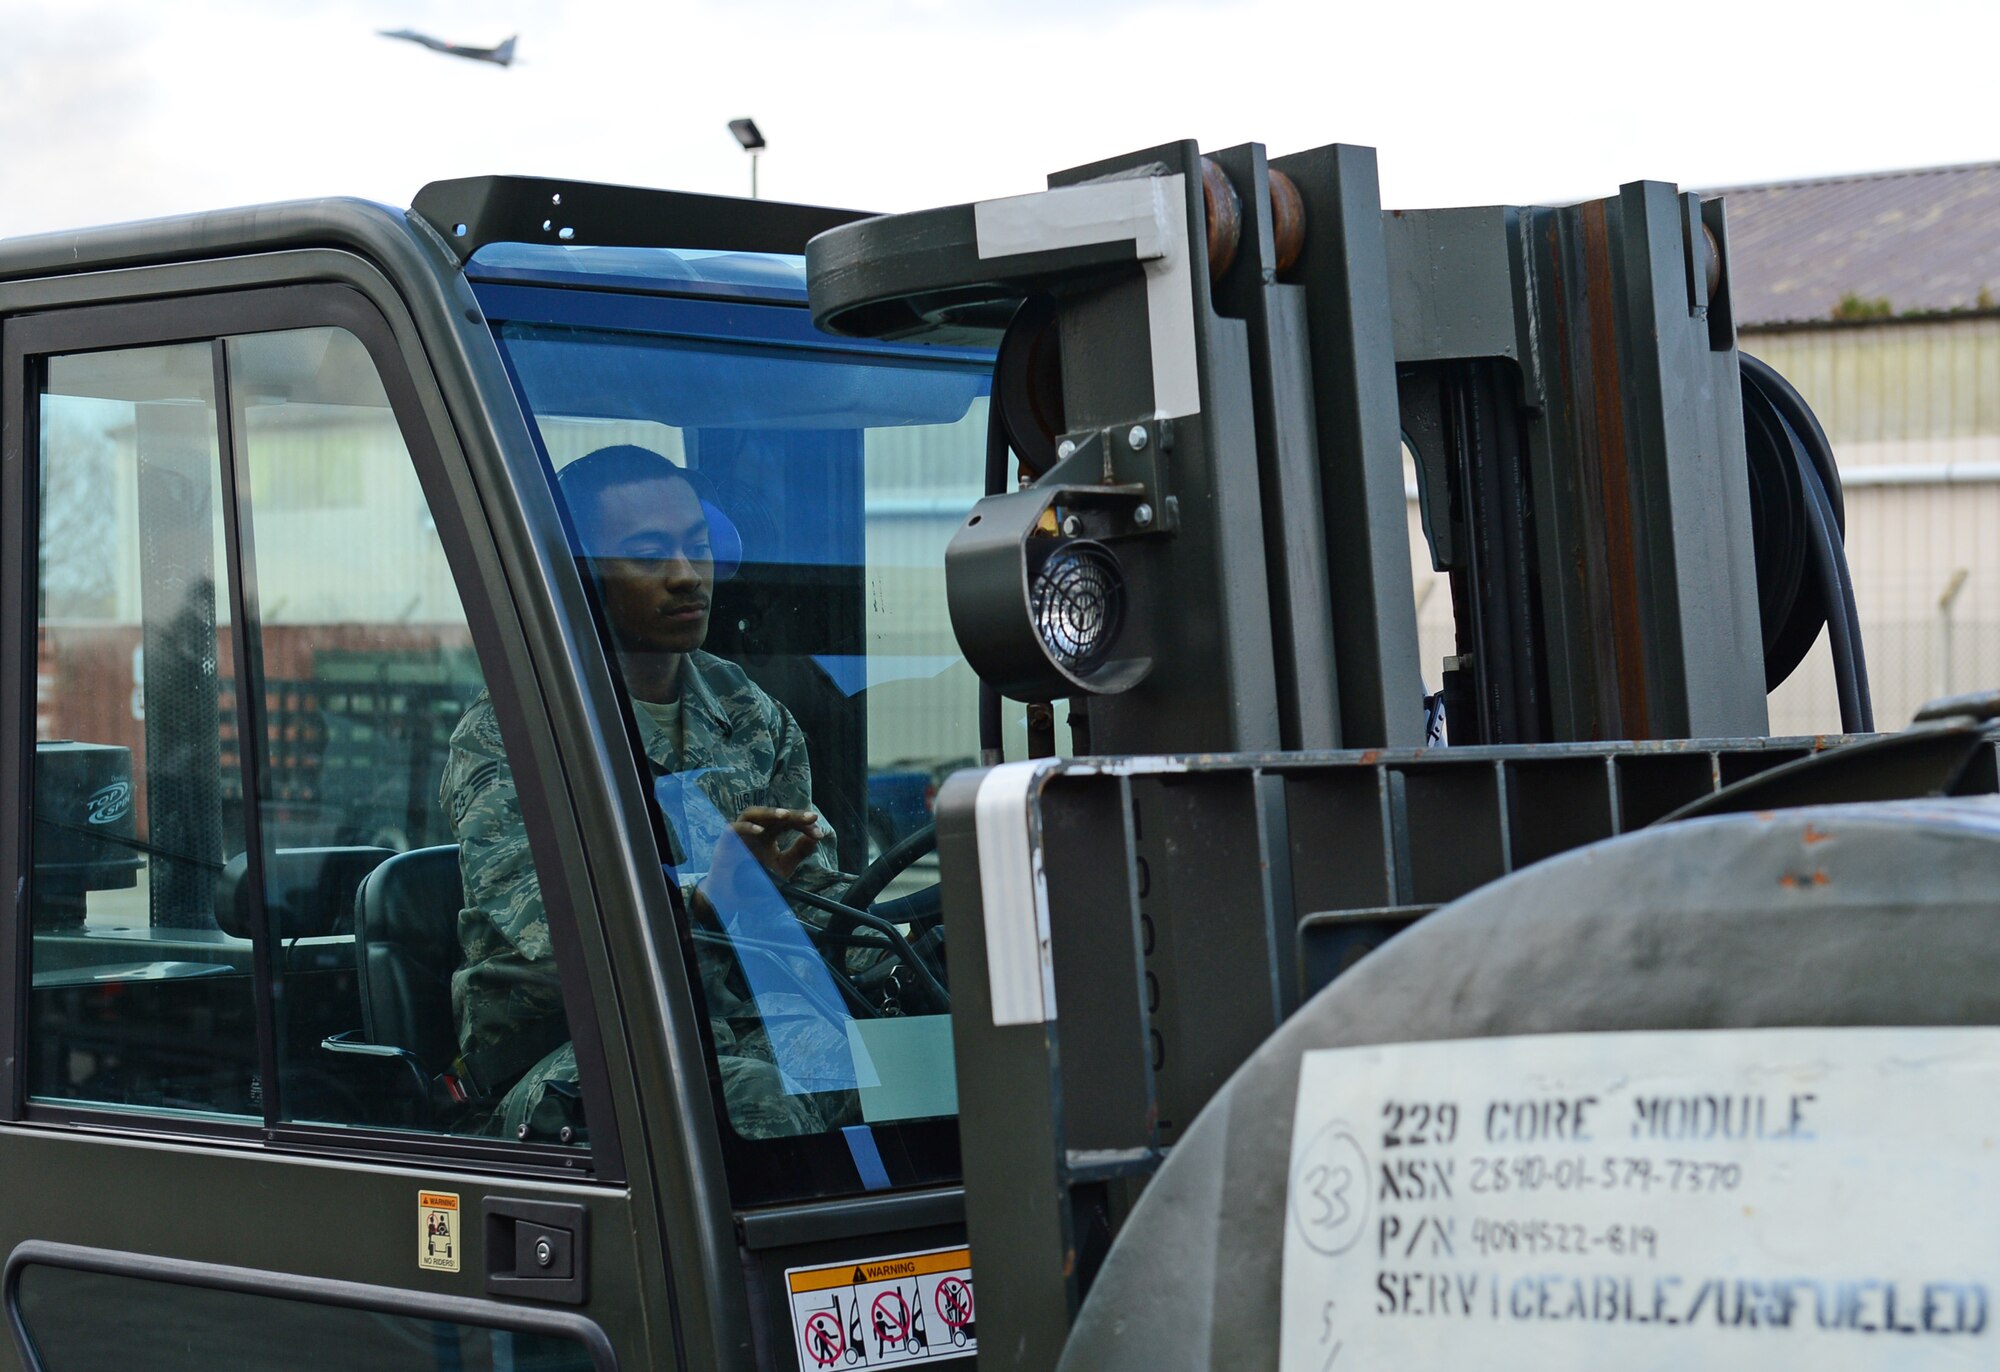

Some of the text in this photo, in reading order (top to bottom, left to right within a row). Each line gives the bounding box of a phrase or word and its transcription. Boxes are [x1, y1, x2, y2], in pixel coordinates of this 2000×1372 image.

[87, 790, 118, 810] TOP
[107, 793, 130, 816] SPIN
[1383, 1093, 1817, 1148] 229 CORE MODULE
[1380, 1159, 1454, 1201] NSN
[430, 1197, 456, 1208] WARNING
[1304, 1163, 1353, 1230] 33
[1379, 1215, 1456, 1259] P/N
[423, 1257, 433, 1265] NO
[866, 1261, 916, 1277] WARNING
